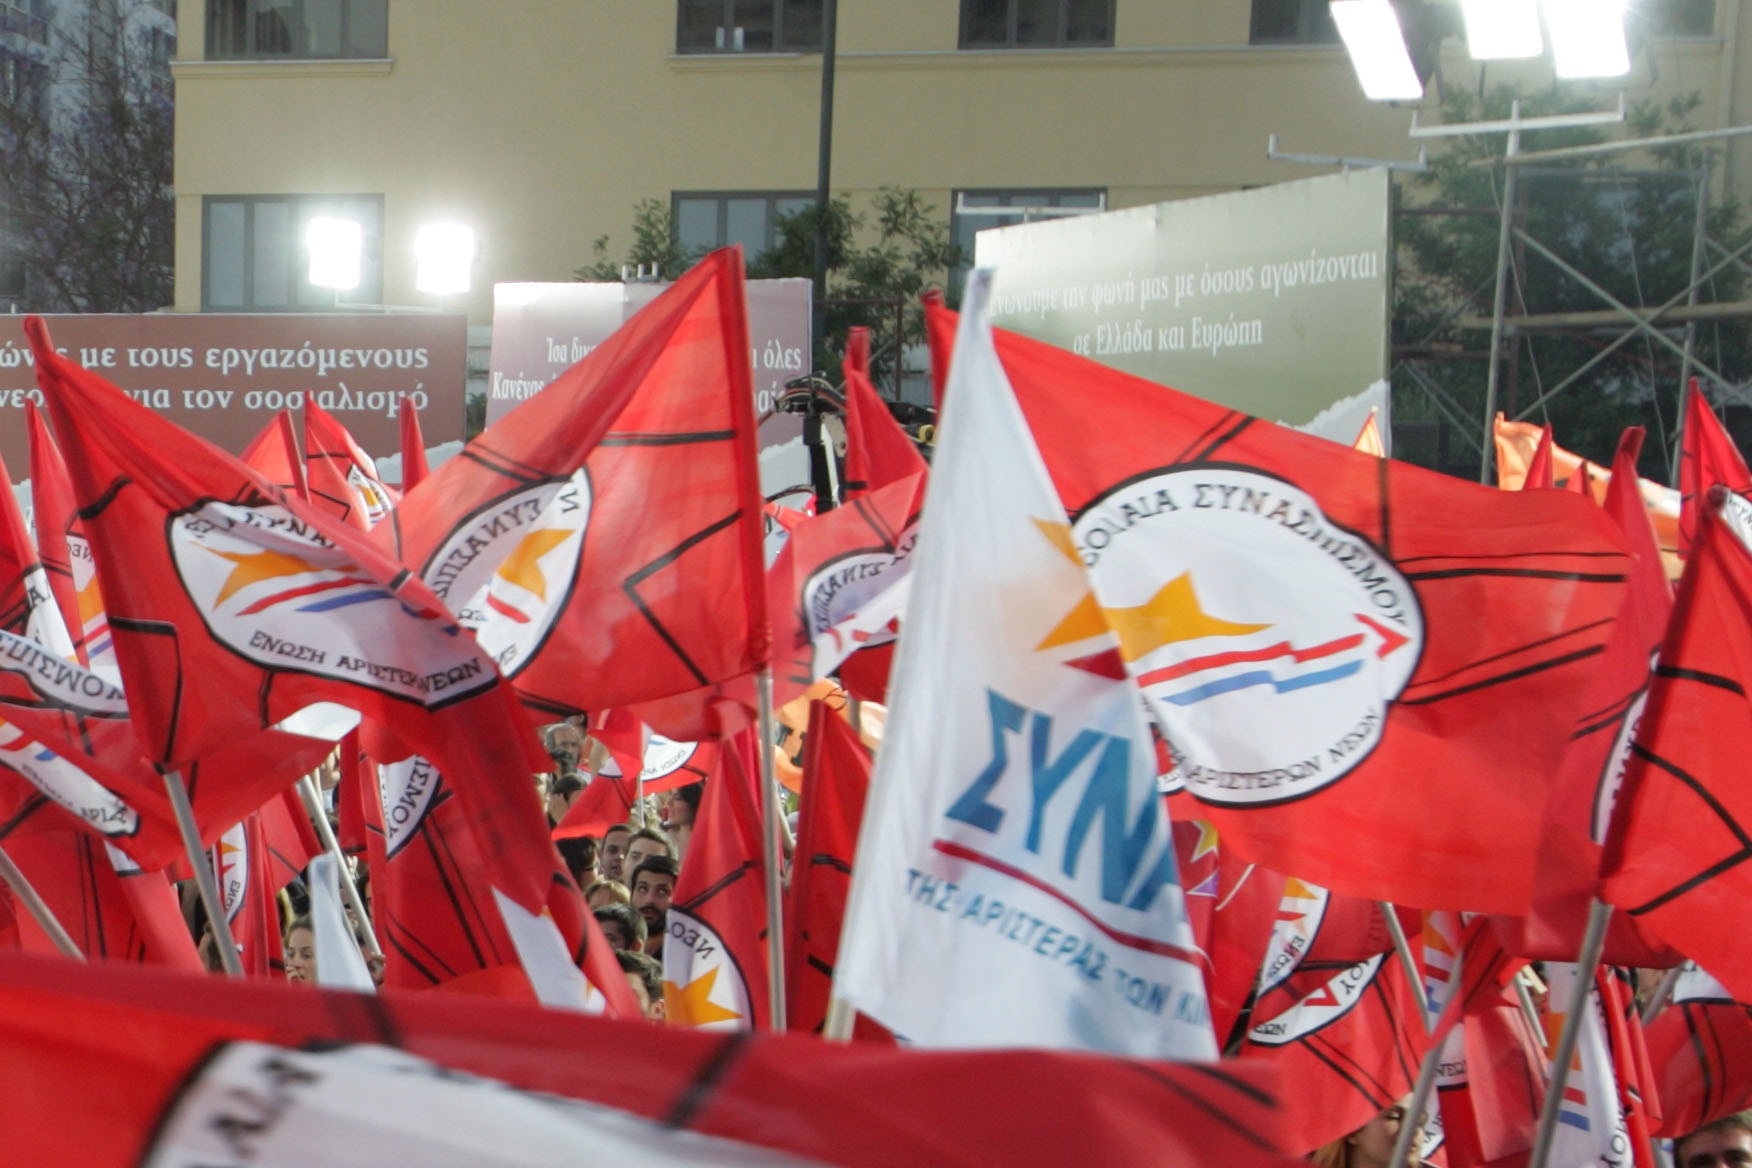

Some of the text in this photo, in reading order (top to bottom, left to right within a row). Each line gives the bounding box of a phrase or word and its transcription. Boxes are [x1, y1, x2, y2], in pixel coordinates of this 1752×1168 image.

[1092, 271, 1135, 314] φωνή
[1140, 275, 1169, 311] μας
[1175, 272, 1195, 308] με
[1201, 261, 1254, 297] όσους
[1260, 247, 1378, 298] αγωνίζονται
[1096, 318, 1153, 356] Ελλάδα
[1159, 325, 1185, 351] και
[1191, 312, 1263, 358] Ευρώπη
[80, 347, 117, 370] με
[128, 346, 194, 369] τους
[205, 340, 429, 376] εργαζόμενους
[763, 339, 801, 371] όλες
[182, 388, 234, 410] τον
[250, 630, 327, 666] ΕΝΩΣΗ
[907, 868, 960, 913] ΤΗΣ
[961, 893, 1111, 982] ΑΡΙΣΤΕΡΑΣ
[1114, 967, 1172, 1016] ΤΩΝ
